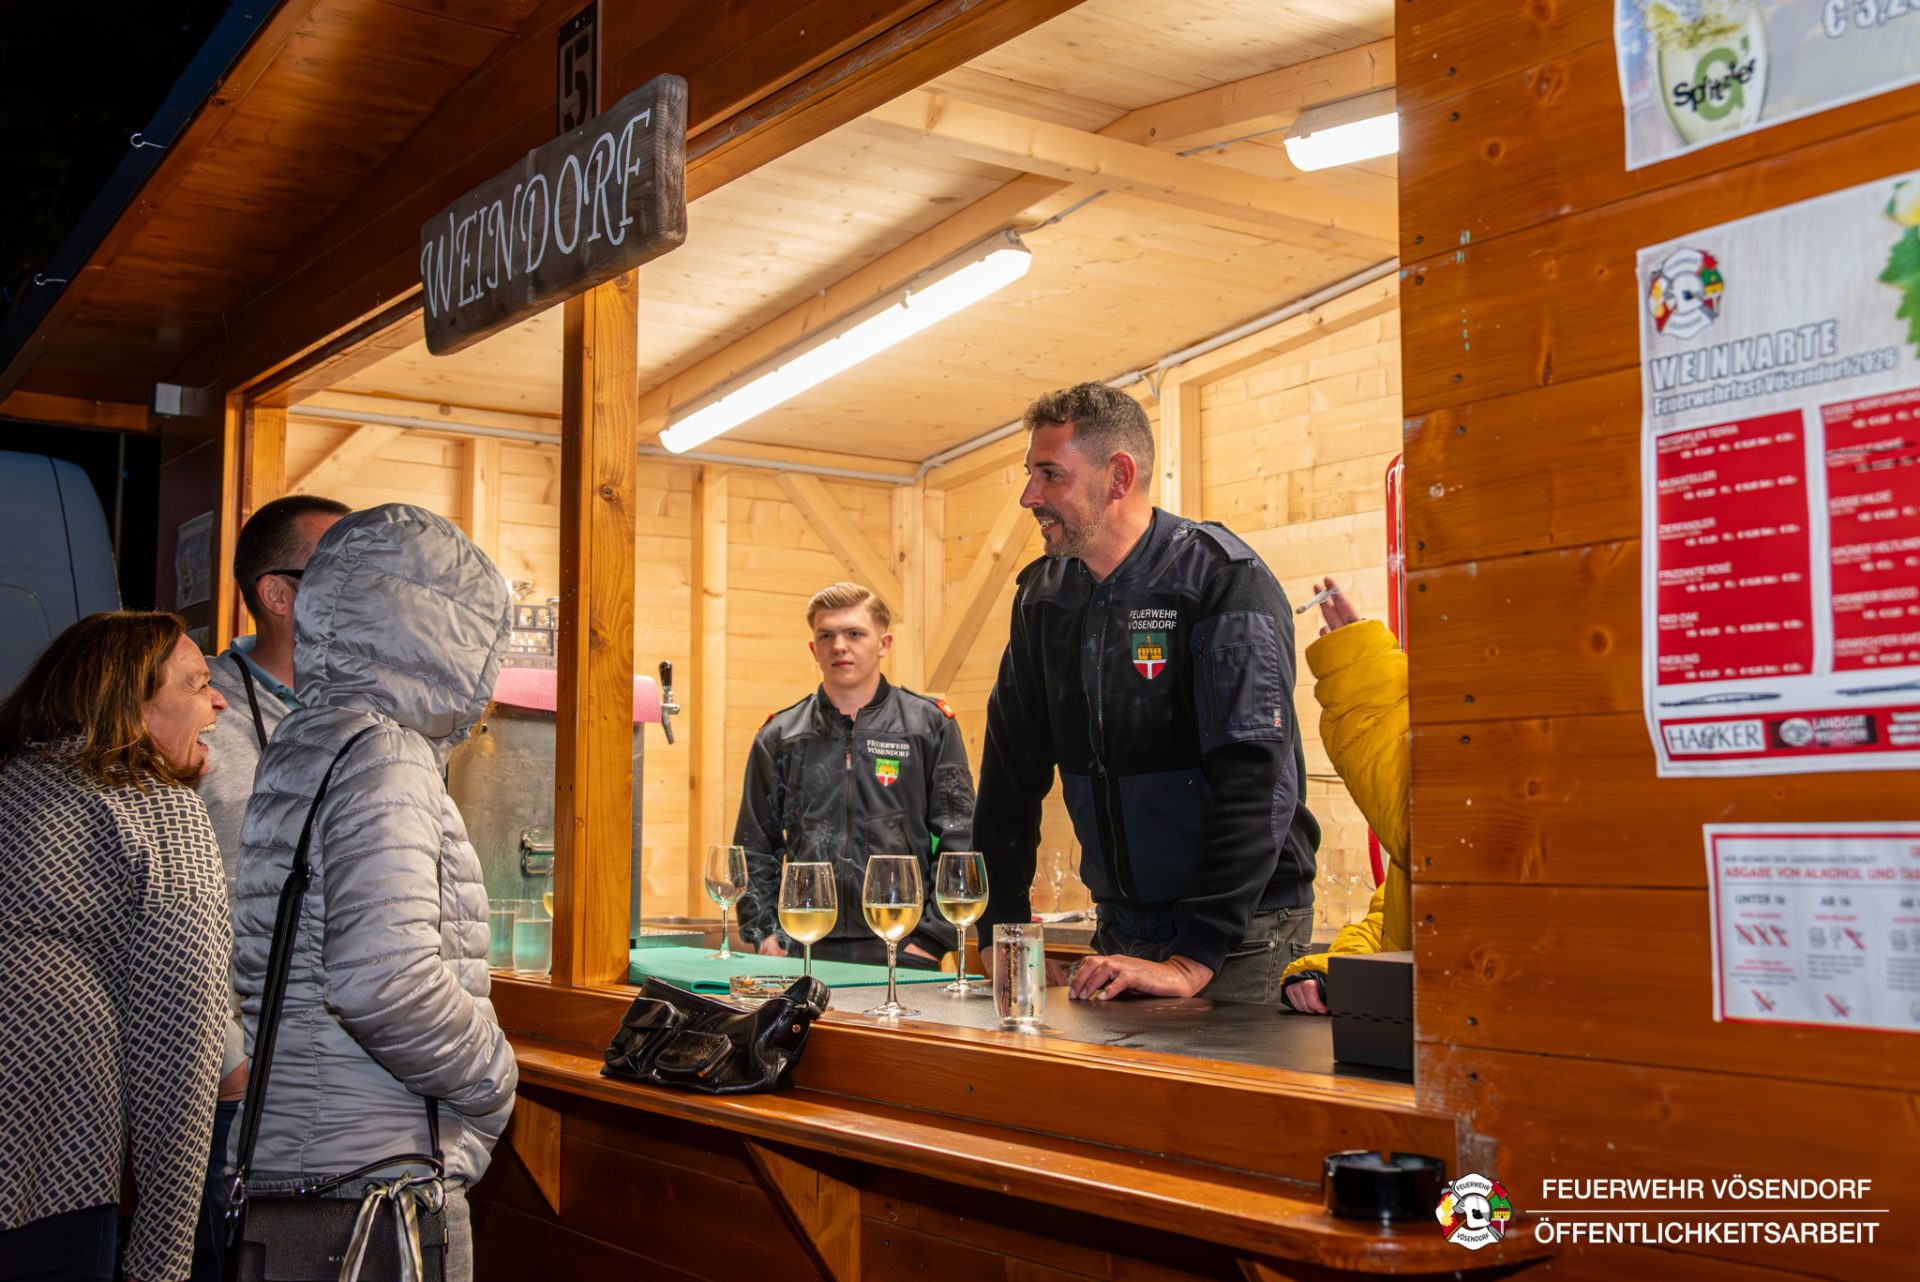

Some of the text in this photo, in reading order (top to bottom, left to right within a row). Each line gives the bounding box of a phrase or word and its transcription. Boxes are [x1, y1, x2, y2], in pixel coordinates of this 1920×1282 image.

[421, 107, 650, 320] WEINDORF
[1650, 318, 1837, 393] WEINKARTE
[1129, 608, 1178, 620] FEUERWEHR
[1127, 620, 1177, 630] VÖSENDORF
[1724, 866, 1772, 880] ABGABE
[1777, 866, 1800, 879] VON
[1804, 867, 1863, 881] ALKOHOL
[1867, 867, 1896, 881] UND
[1735, 893, 1770, 905] UNTER
